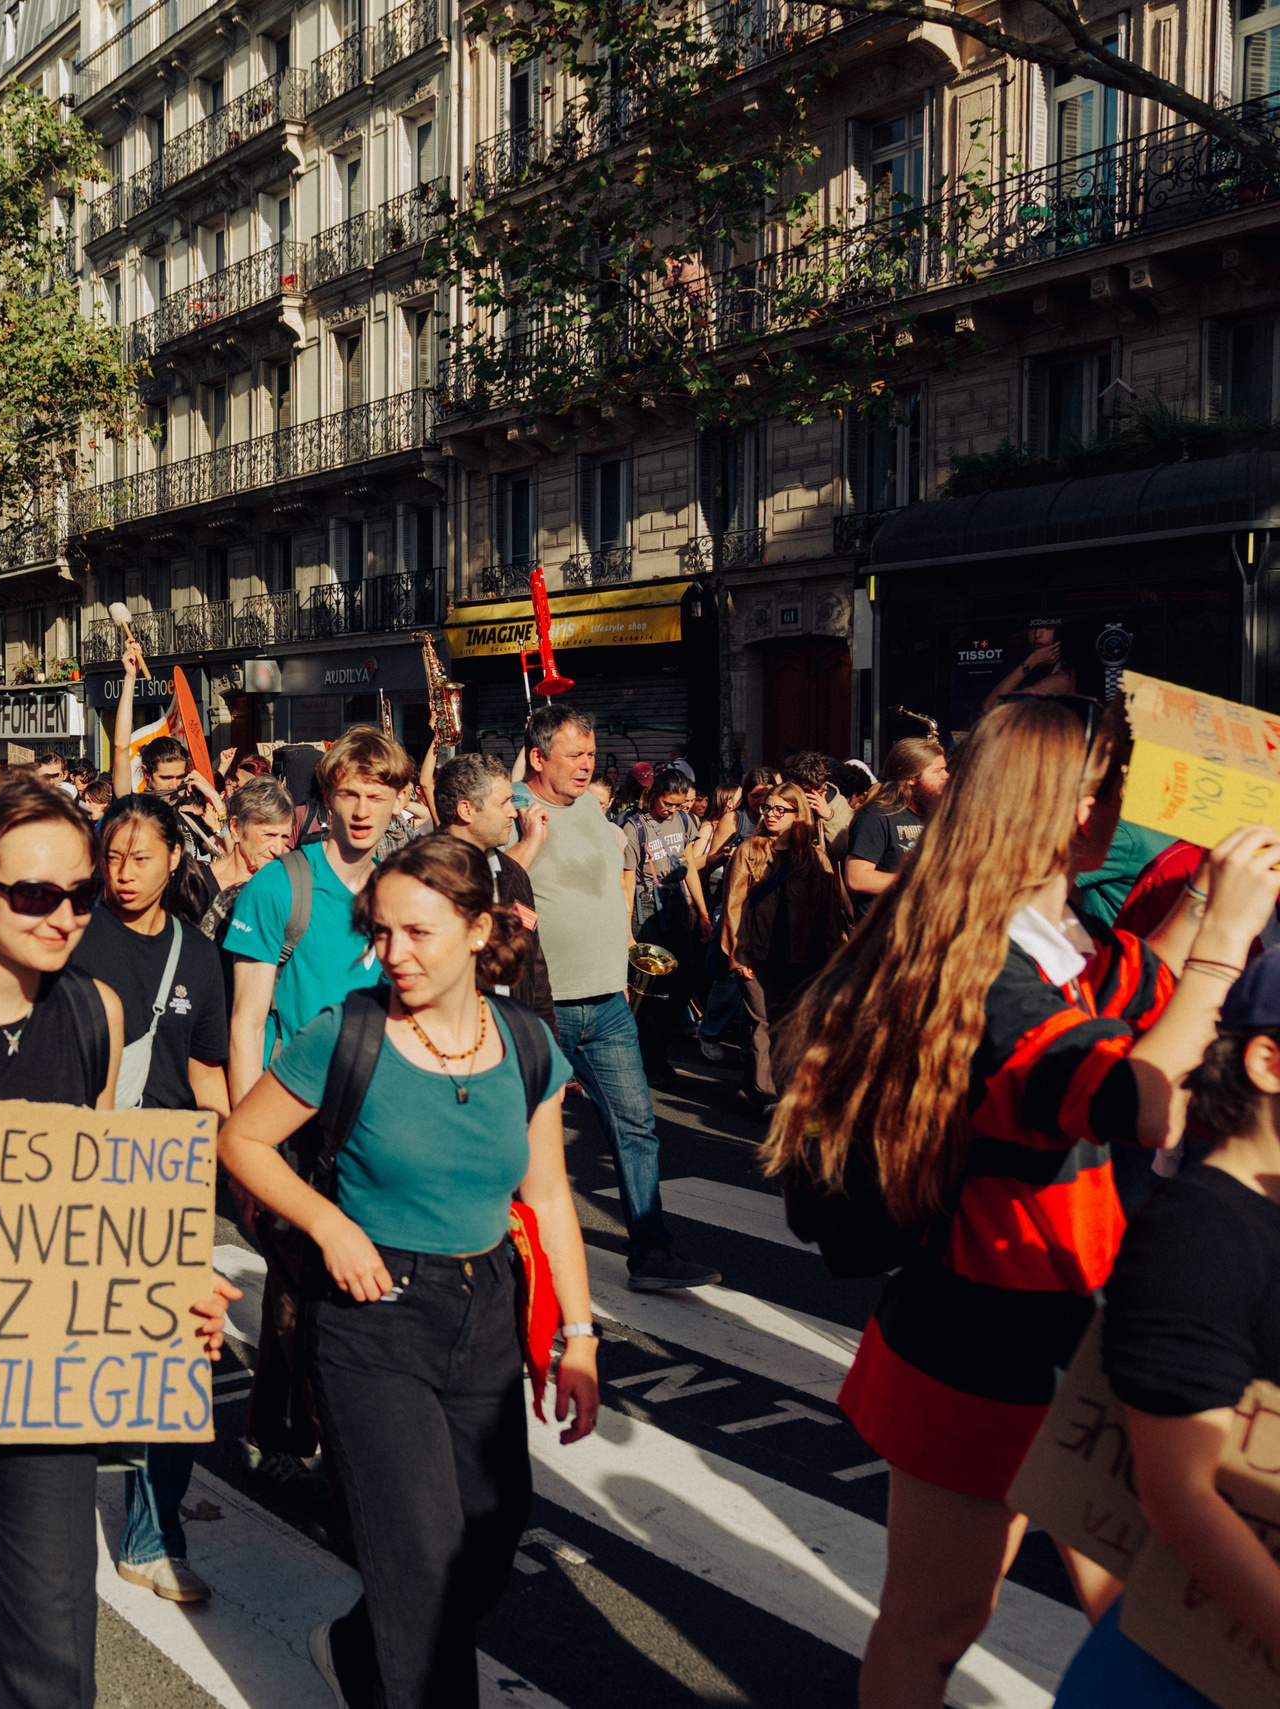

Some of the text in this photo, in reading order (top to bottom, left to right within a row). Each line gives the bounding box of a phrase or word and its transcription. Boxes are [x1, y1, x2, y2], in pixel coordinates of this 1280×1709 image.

[1029, 618, 1062, 626] JCDecaux
[466, 624, 534, 646] IMAGINE
[627, 622, 647, 632] shop
[612, 634, 654, 642] Carterie
[958, 649, 1003, 660] TISSOT
[324, 668, 369, 685] AUDILYA
[66, 1278, 179, 1341] LES
